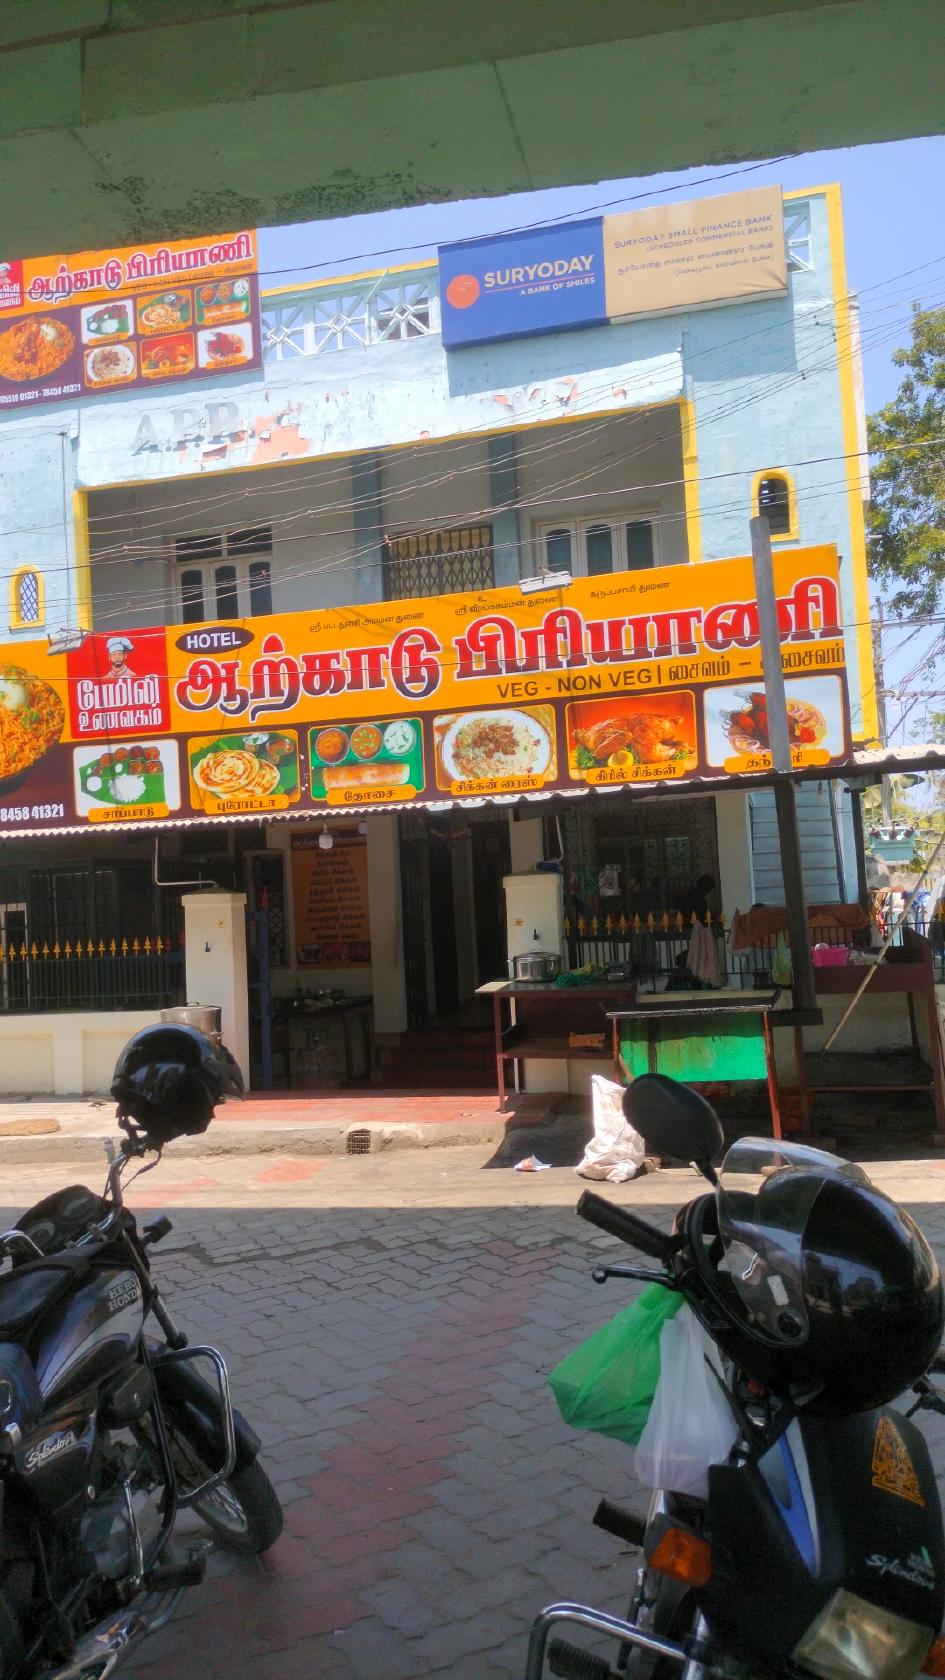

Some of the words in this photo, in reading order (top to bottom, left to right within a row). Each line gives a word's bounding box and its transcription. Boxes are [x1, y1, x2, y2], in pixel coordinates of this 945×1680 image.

[614, 233, 664, 249] SURYODAY
[668, 228, 698, 240] SMALL
[701, 220, 743, 234] FINANCE
[745, 214, 773, 226] BANK
[28, 259, 122, 304] ஆற்காடு
[126, 232, 253, 280] பிரியாணி
[484, 254, 594, 288] SURYODAY
[528, 284, 551, 294] BANK
[552, 282, 564, 290] OF
[566, 277, 595, 288] SMILES
[174, 627, 444, 722] ஆற்காடு
[454, 576, 844, 680] பிரியாணி
[186, 632, 242, 650] HOTEL
[497, 680, 538, 698] VEG
[558, 674, 602, 692] NON
[608, 668, 652, 686] VEG
[668, 656, 730, 681] சைவம்
[760, 643, 844, 670] சைவம்
[77, 674, 160, 710] பேமிலி
[78, 701, 162, 732] உணவகம்
[596, 768, 627, 782] கிரில்
[632, 764, 676, 779] சிக்கன்
[344, 788, 396, 802] தோசை
[456, 778, 497, 792] சிக்கன்
[32, 803, 64, 820] 41321
[102, 806, 154, 819] சாப்பாடு
[217, 798, 276, 813] புரோட்டா
[108, 1278, 136, 1299] HERO
[108, 1288, 140, 1312] HOND
